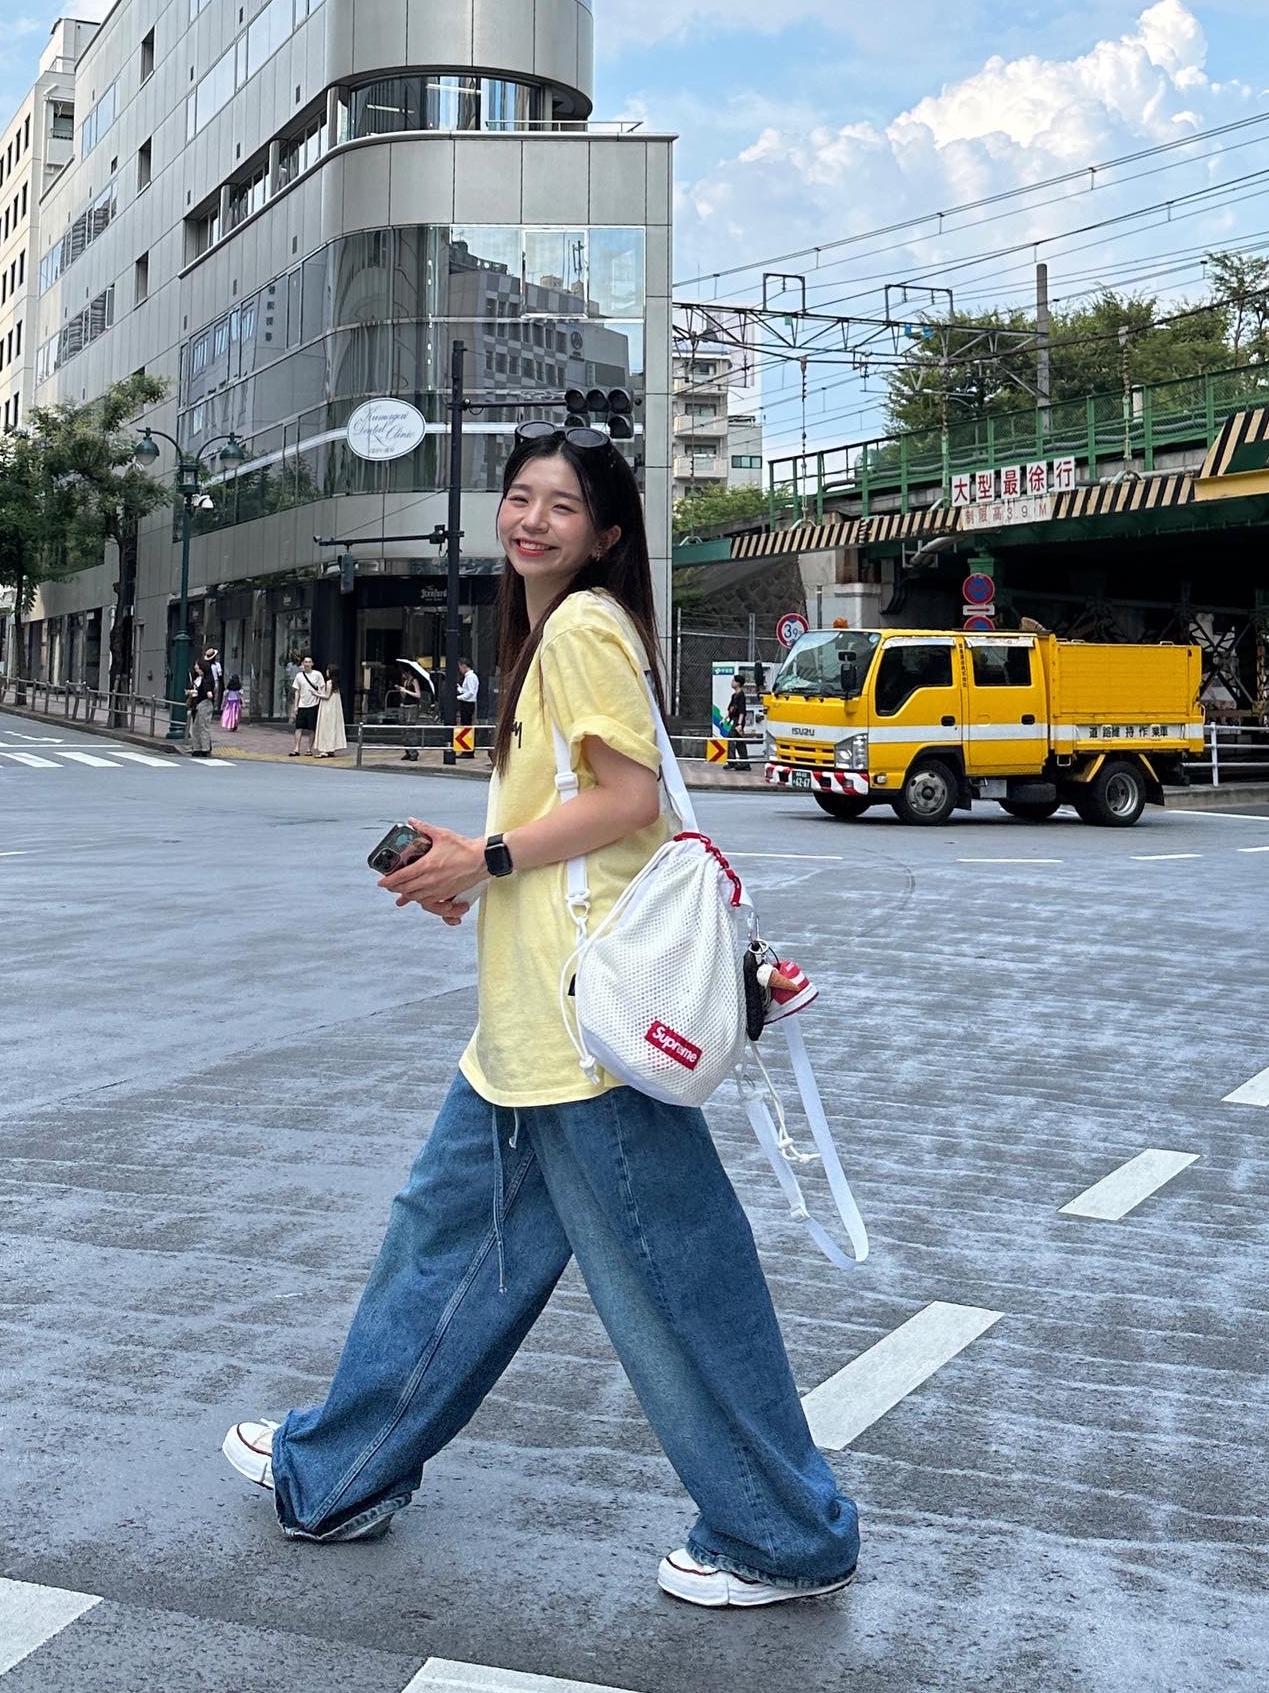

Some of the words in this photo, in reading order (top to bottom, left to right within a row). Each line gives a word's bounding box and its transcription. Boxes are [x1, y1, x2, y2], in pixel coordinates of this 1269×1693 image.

[953, 460, 1073, 503] 大型最徐行
[791, 727, 815, 737] ISUZU
[652, 1026, 698, 1063] Supreme
